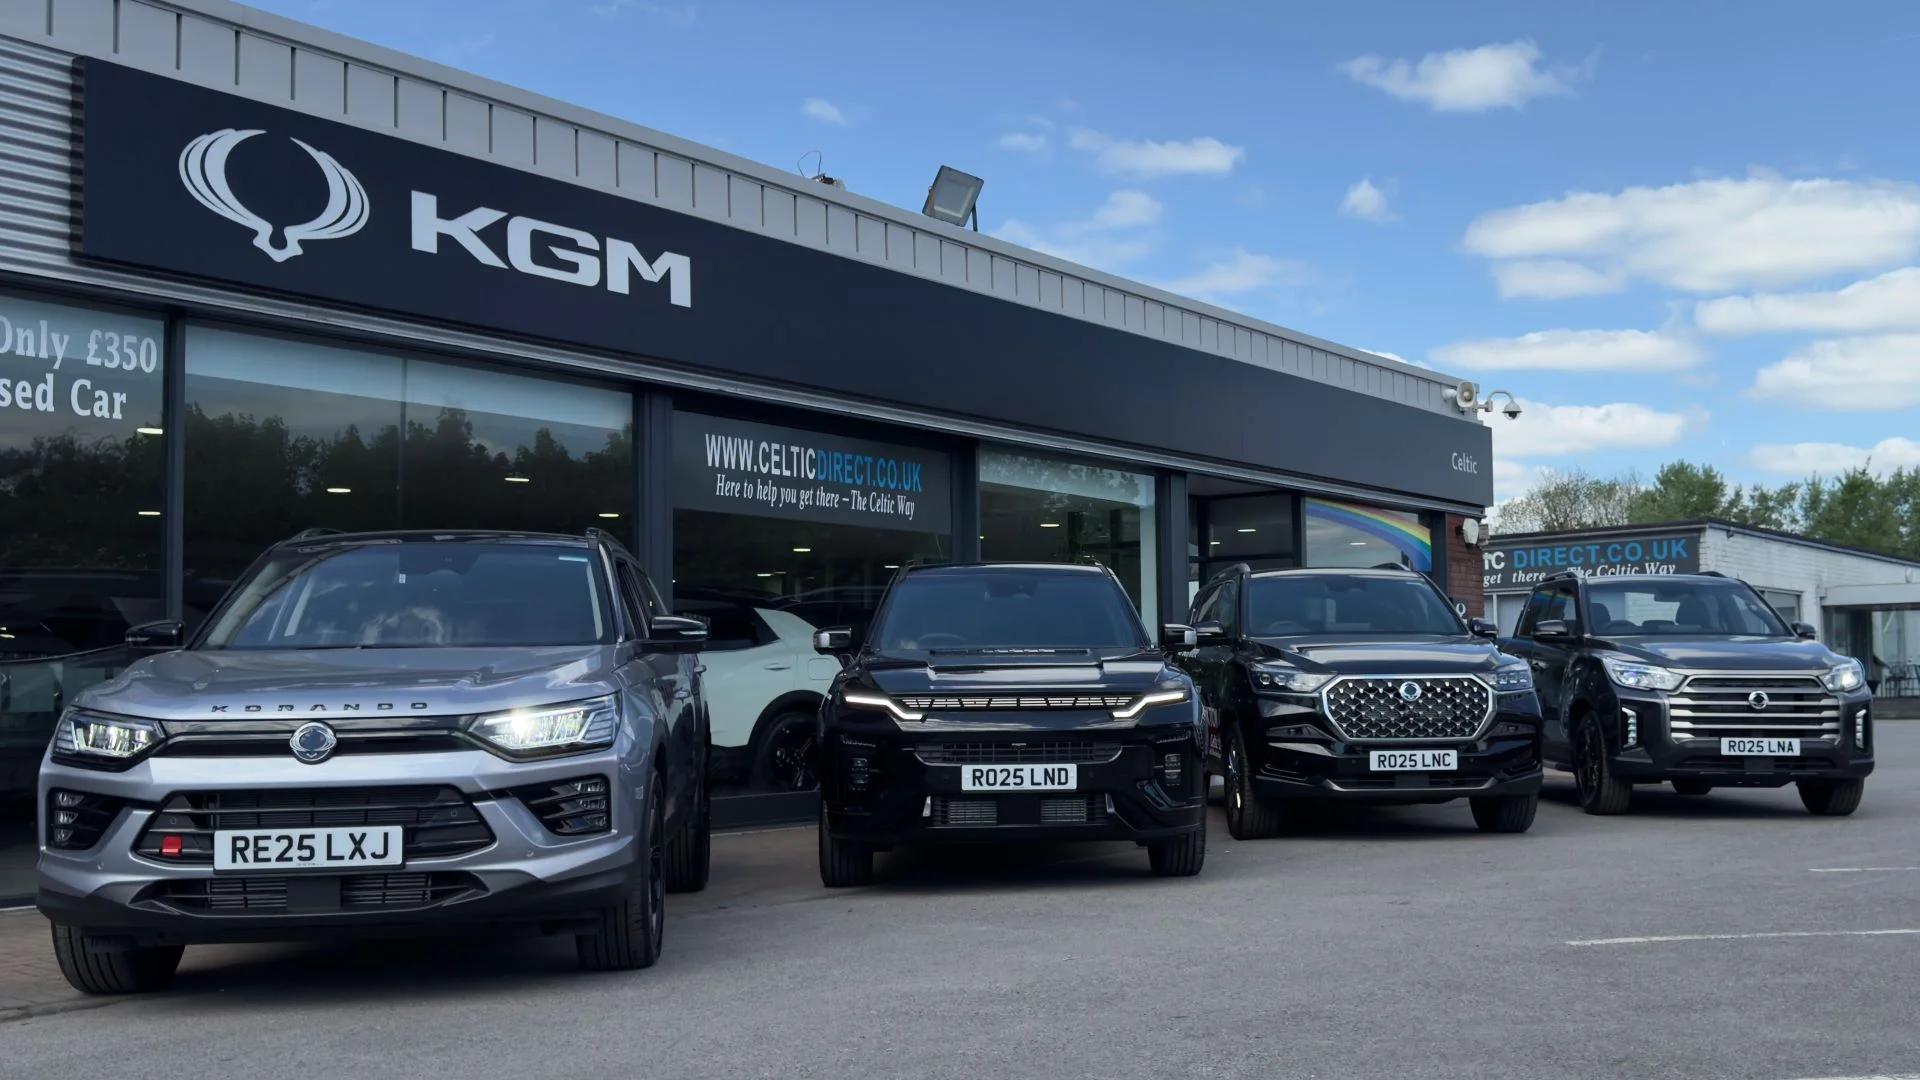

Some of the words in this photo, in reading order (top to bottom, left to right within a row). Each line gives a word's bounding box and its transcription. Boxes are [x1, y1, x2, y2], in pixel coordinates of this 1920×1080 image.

[411, 190, 692, 308] KGM
[0, 315, 70, 370] Only
[86, 329, 158, 374] £350
[0, 373, 55, 412] sed
[70, 378, 127, 420] Car
[705, 433, 922, 493] WWW.CELTICDIRECT.CO.UK
[1451, 452, 1479, 475] Celtic
[716, 474, 741, 498] Here
[743, 479, 754, 499] to
[757, 478, 777, 507] help
[780, 487, 797, 508] you
[799, 488, 814, 510] get
[816, 489, 840, 508] there
[869, 492, 895, 514] Celtic
[897, 495, 915, 520] Way
[1513, 539, 1688, 569] DIRECT.CO.UK
[1483, 573, 1502, 588] get
[1512, 569, 1546, 583] there
[1597, 564, 1639, 577] Celtic
[1645, 562, 1676, 575] Way
[211, 702, 428, 713] KORANDO
[1378, 754, 1417, 768] RO25
[1422, 753, 1451, 767] LNC
[1728, 740, 1764, 753] RO25
[1769, 740, 1794, 753] LNA
[972, 768, 1024, 787] RO25
[1030, 767, 1069, 786] LND
[231, 834, 316, 864] RE25
[326, 831, 389, 861] LXJ
